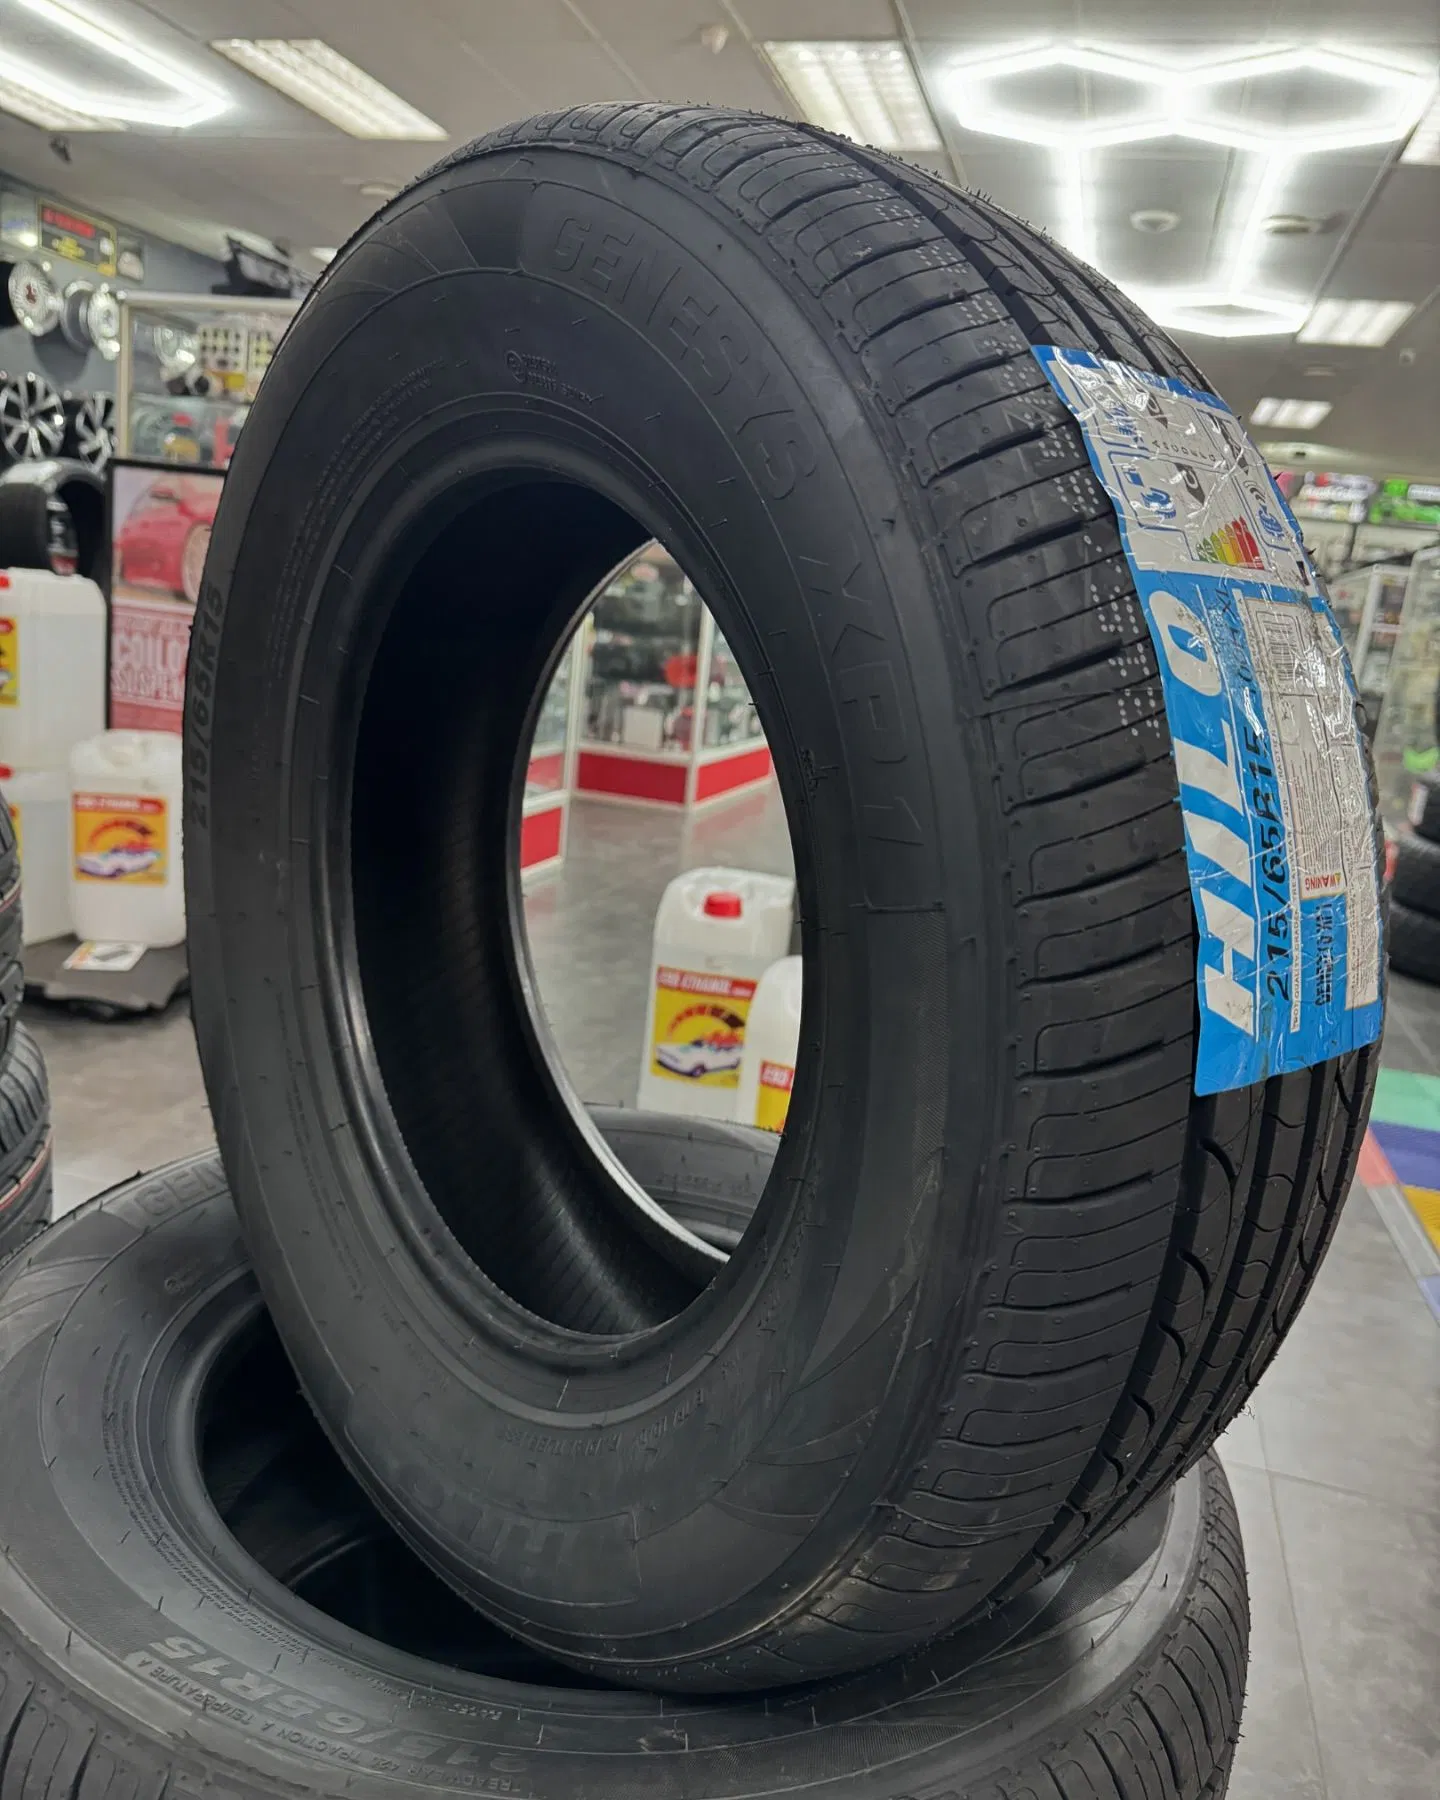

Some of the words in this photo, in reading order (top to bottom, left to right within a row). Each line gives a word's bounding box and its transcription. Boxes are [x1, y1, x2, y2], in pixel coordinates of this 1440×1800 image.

[188, 585, 225, 828] 215/65R15
[1149, 591, 1254, 1036] HILO
[1246, 727, 1290, 1001] 215/65R15
[147, 1634, 530, 1773] 215/65R15
[275, 1726, 360, 1766] TRACTION
